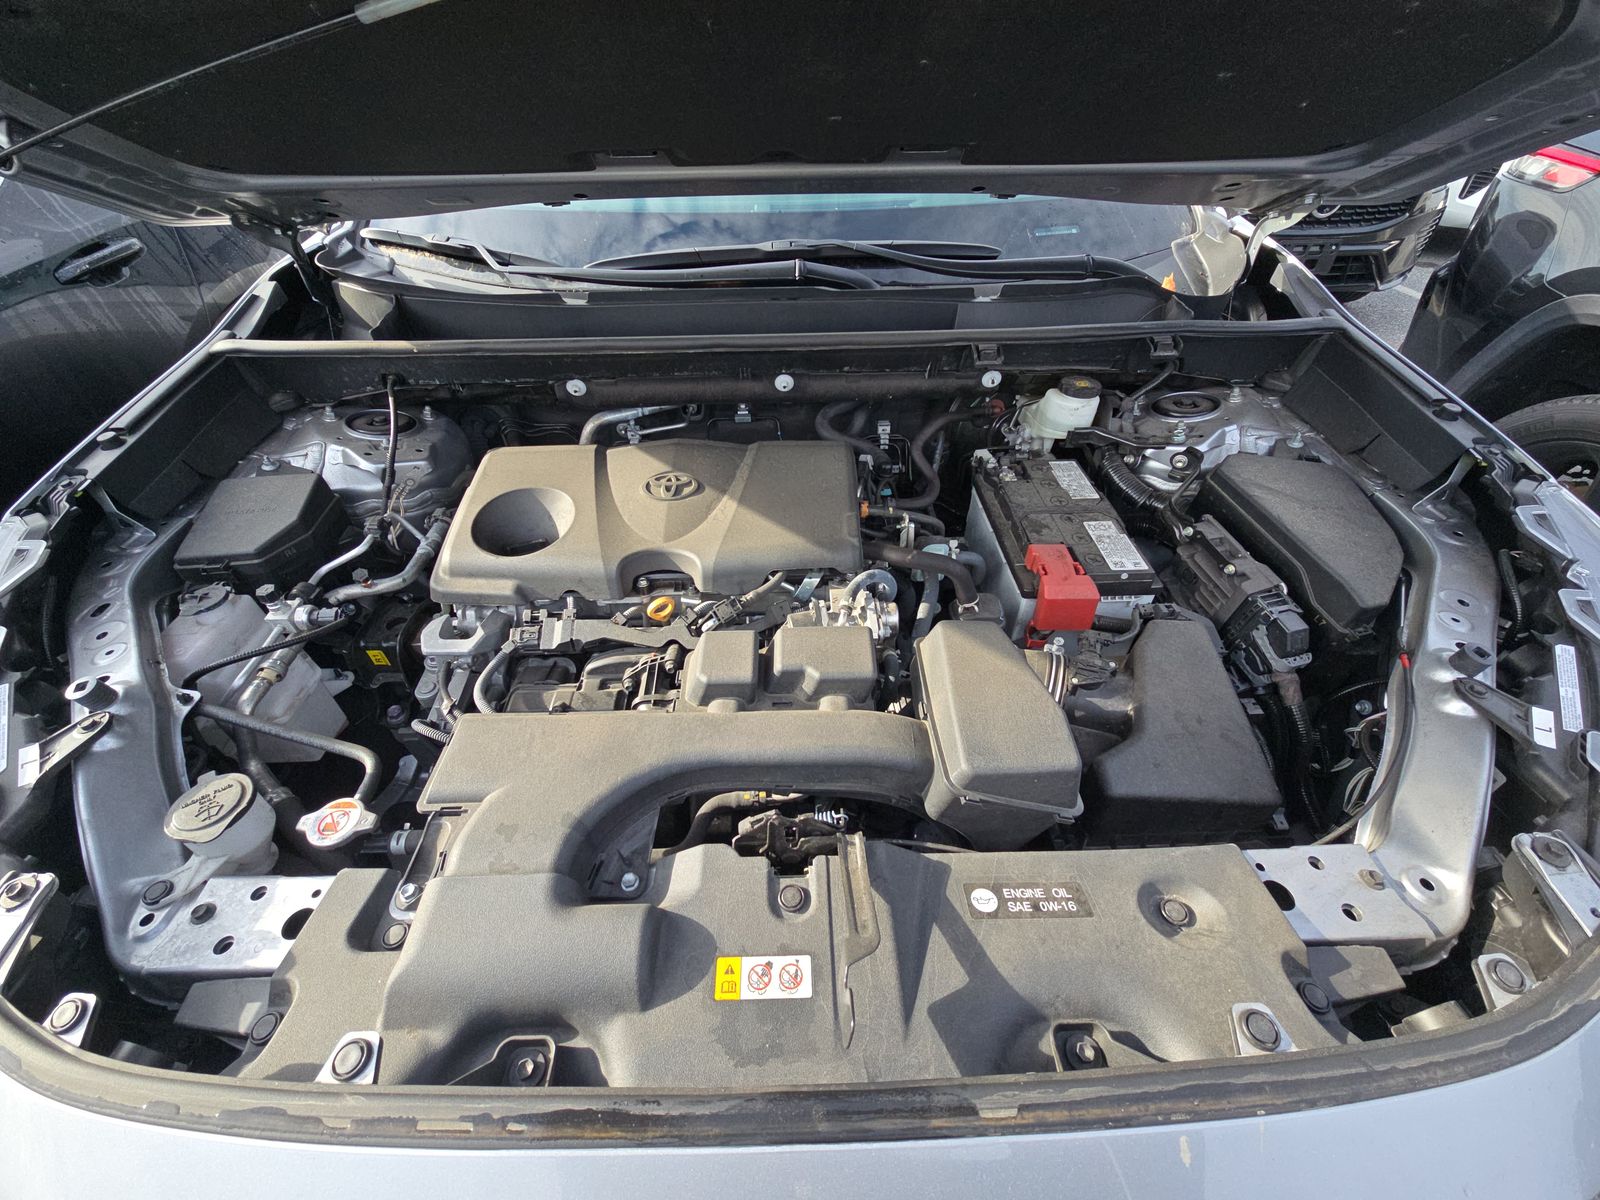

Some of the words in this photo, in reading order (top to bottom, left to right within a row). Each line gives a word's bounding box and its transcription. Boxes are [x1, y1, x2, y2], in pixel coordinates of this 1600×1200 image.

[1002, 887, 1046, 899] ENGINE
[1051, 887, 1073, 899] OIL
[1007, 901, 1033, 912] SAE
[1039, 900, 1077, 912] 0W-16
